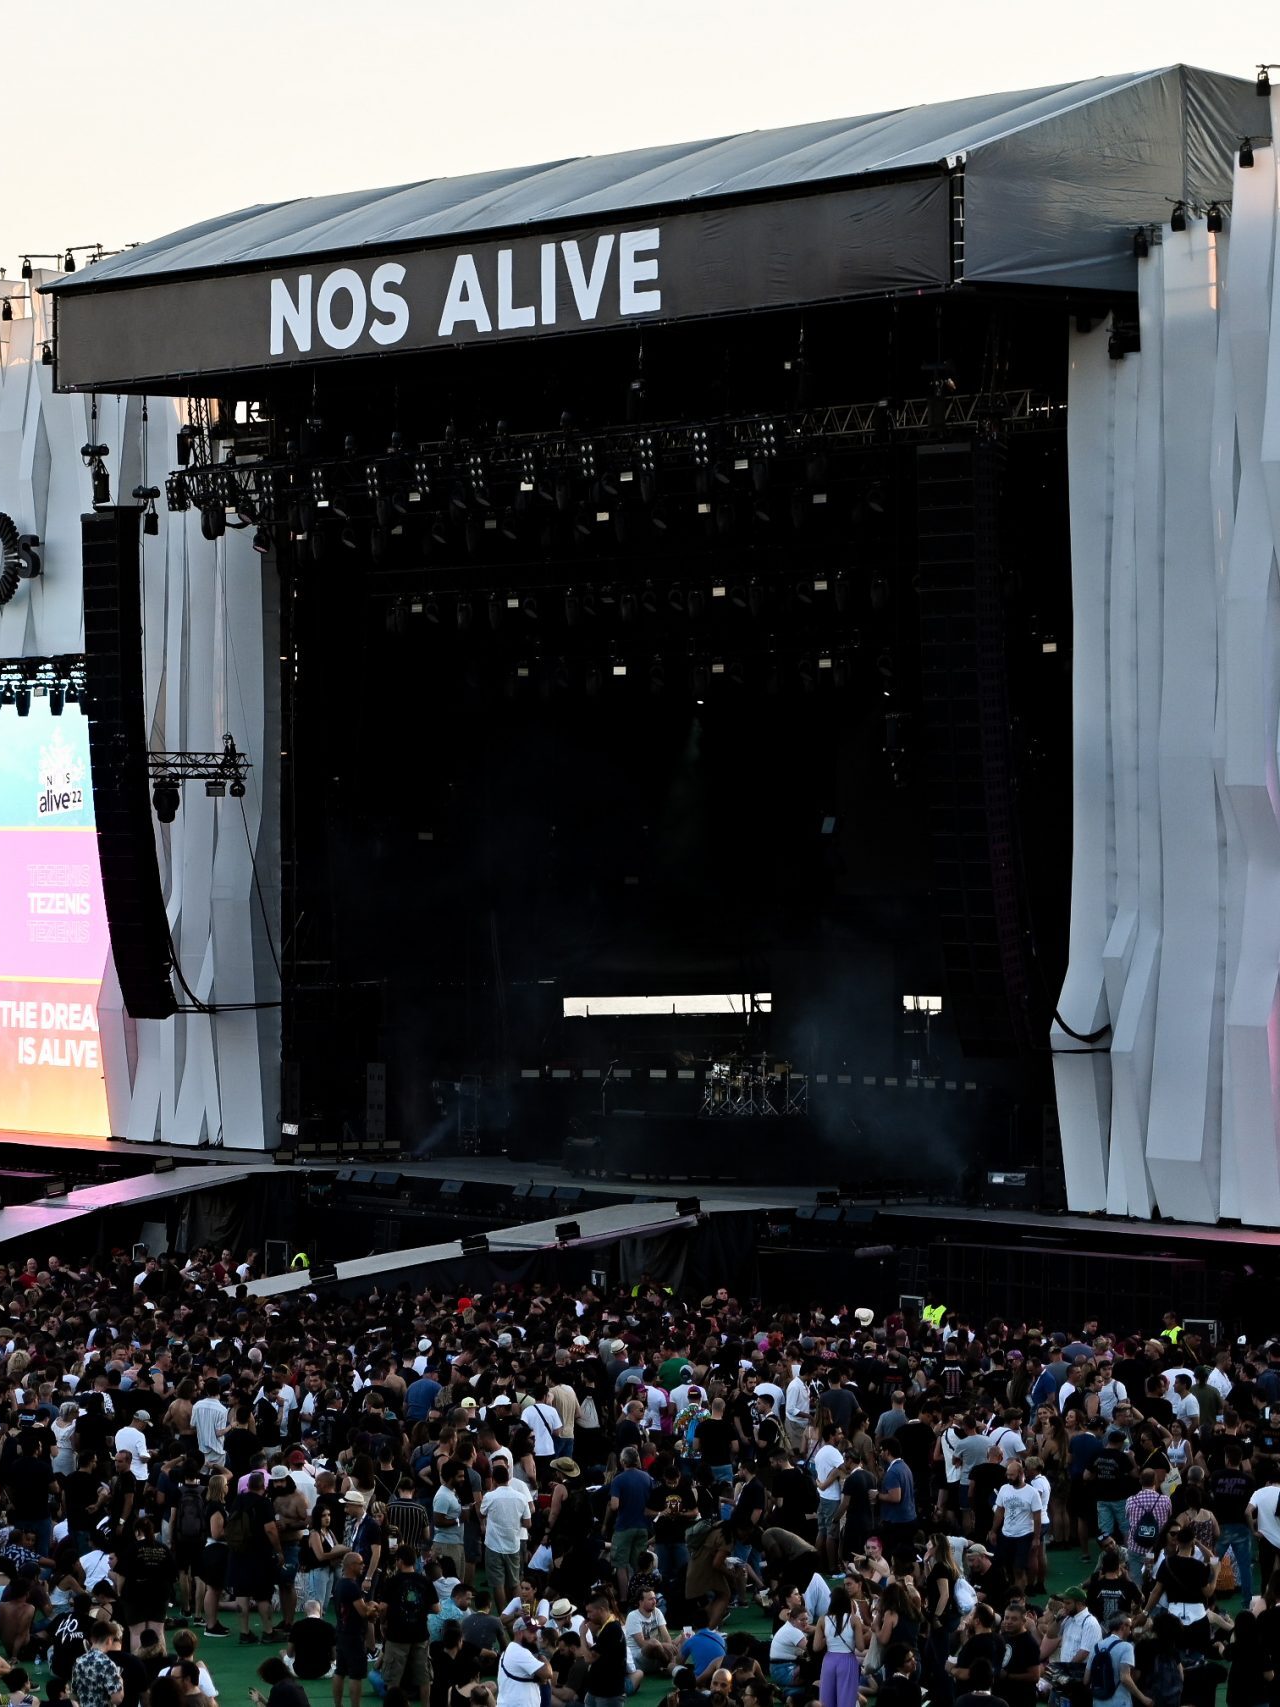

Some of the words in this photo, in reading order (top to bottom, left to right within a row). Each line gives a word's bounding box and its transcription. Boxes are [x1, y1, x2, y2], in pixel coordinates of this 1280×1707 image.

[270, 262, 410, 355] NOS
[437, 228, 661, 336] ALIVE
[27, 892, 91, 915] TEZENIS
[0, 1000, 38, 1028] THE
[41, 1002, 99, 1031] DREA
[18, 1037, 36, 1065] IS
[38, 1038, 98, 1068] ALIVE
[55, 1613, 78, 1644] 40
